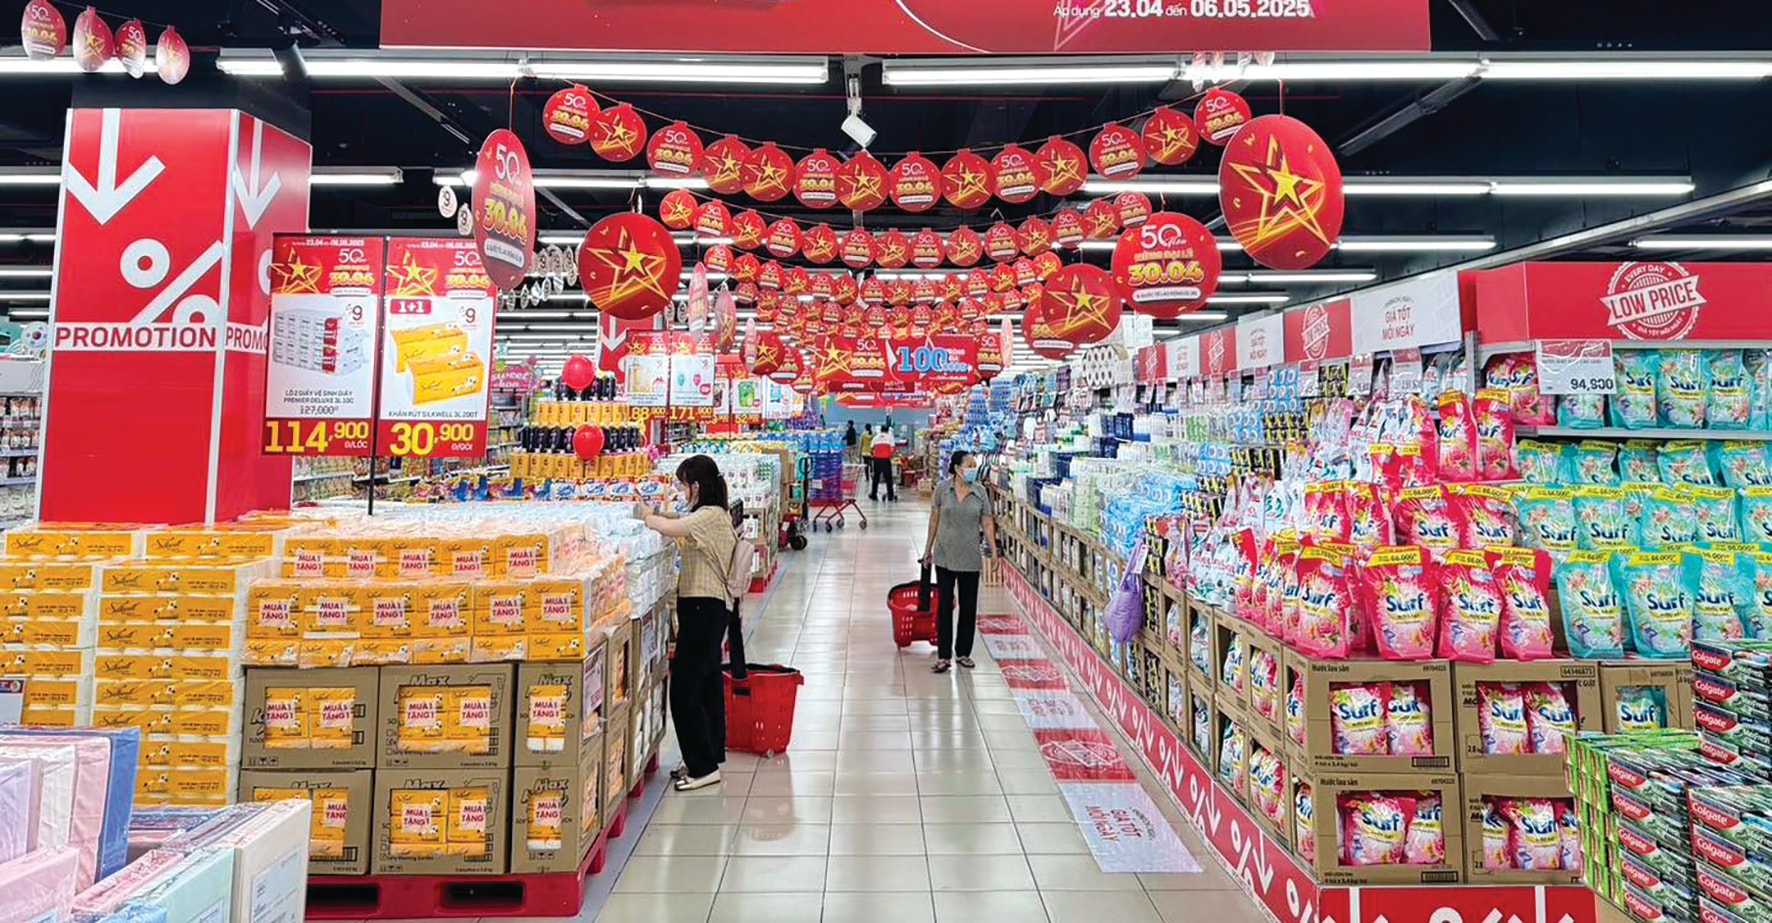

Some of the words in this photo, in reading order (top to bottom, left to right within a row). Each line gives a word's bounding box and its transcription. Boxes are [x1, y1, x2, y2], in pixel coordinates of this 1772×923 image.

[1071, 4, 1101, 18] dụng
[1104, 0, 1163, 17] 23.04
[1165, 2, 1187, 16] đến
[1190, 0, 1309, 17] 06.05.2025
[495, 143, 520, 182] 50
[1141, 224, 1182, 249] 50
[339, 248, 364, 263] 50
[454, 250, 480, 266] 50
[1127, 260, 1205, 286] 30.04
[1624, 265, 1648, 283] EVERY
[1648, 264, 1666, 273] DAY
[399, 301, 424, 312] 1+1
[1610, 292, 1646, 319] LOW
[1648, 281, 1697, 310] PRICE
[465, 307, 476, 323] 9
[1397, 304, 1411, 321] TỐT
[55, 326, 216, 349] PROMOTION
[1396, 321, 1415, 338] NGÀY
[857, 339, 879, 351] 50
[897, 346, 950, 373] 100
[264, 420, 369, 452] 114,900
[389, 421, 474, 456] 30,900
[1419, 521, 1450, 538] Surf
[1541, 525, 1577, 541] Surf
[1591, 523, 1629, 539] Surf
[298, 554, 317, 562] MUA
[351, 554, 369, 562] MUA
[456, 555, 474, 564] MUA
[509, 550, 529, 559] MUA
[493, 599, 513, 608] MUA
[545, 597, 563, 606] MUA
[1302, 588, 1336, 608] Surf
[1386, 594, 1425, 612] Surf
[1514, 593, 1541, 610] Surf
[1580, 591, 1617, 608] Surf
[1647, 593, 1685, 610] Surf
[1697, 588, 1734, 604] Surf
[263, 603, 282, 611] MUA
[320, 602, 339, 610] MUA
[377, 602, 396, 610] MUA
[432, 602, 452, 612] MUA
[1692, 650, 1722, 666] Colgate
[1695, 680, 1726, 697] Colgate
[323, 703, 342, 711] MUA
[534, 701, 553, 709] MUA
[1339, 698, 1377, 720] Surf
[1621, 703, 1655, 723] Surf
[1696, 710, 1727, 729] Colgate
[1701, 741, 1729, 759] Colgate
[1609, 763, 1637, 784] Colgate
[533, 778, 569, 790] Max
[327, 803, 347, 811] MUA
[406, 808, 424, 817] MUA
[463, 805, 483, 813] MUA
[537, 802, 556, 810] MUA
[1613, 794, 1641, 817] Colgate
[1692, 802, 1727, 825] Colgate
[1362, 810, 1400, 832] Surf
[1619, 828, 1648, 851] Colgate
[1697, 838, 1733, 864] Colgate
[1622, 860, 1650, 885] Colgate
[1700, 874, 1736, 900] Colgate
[1625, 891, 1653, 916] Colgate
